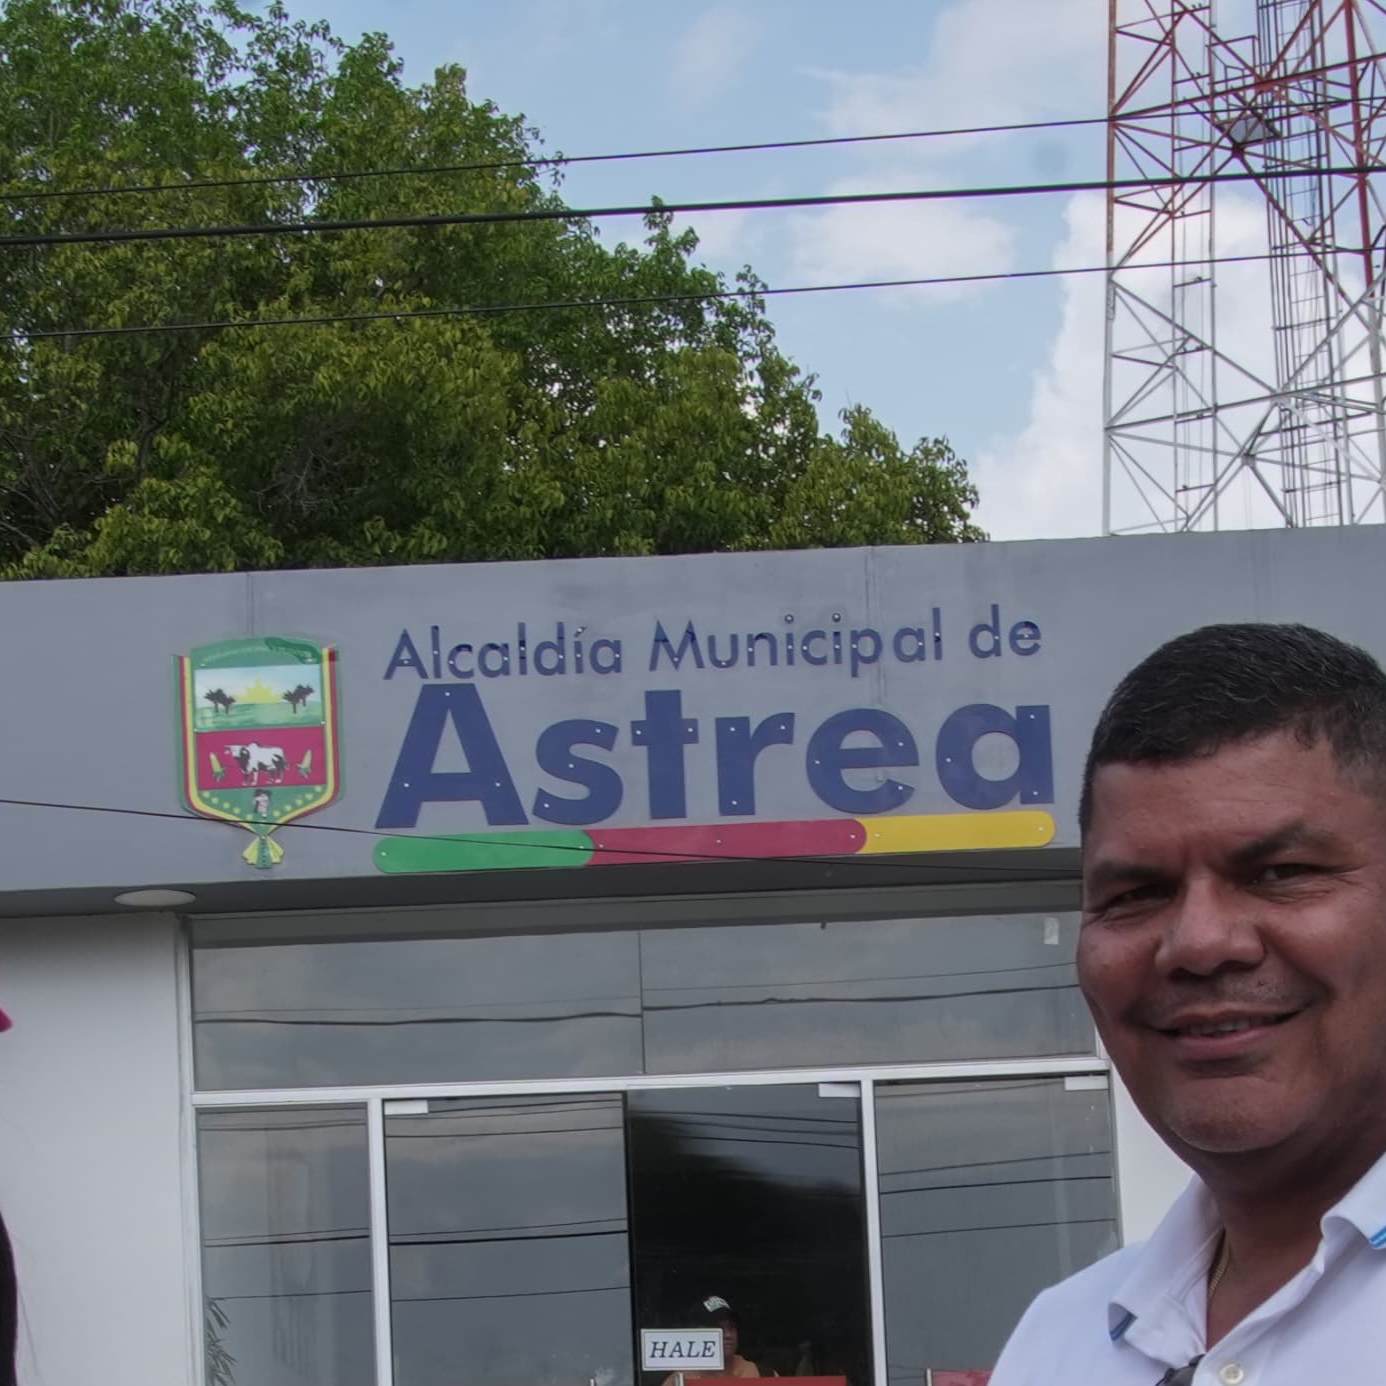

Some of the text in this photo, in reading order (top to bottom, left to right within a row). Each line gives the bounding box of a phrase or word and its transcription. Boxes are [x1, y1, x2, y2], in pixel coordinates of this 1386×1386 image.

[382, 604, 1042, 680] Alcaldía Municipal de
[374, 682, 1055, 830] Astrea
[649, 1340, 717, 1359] HALE
